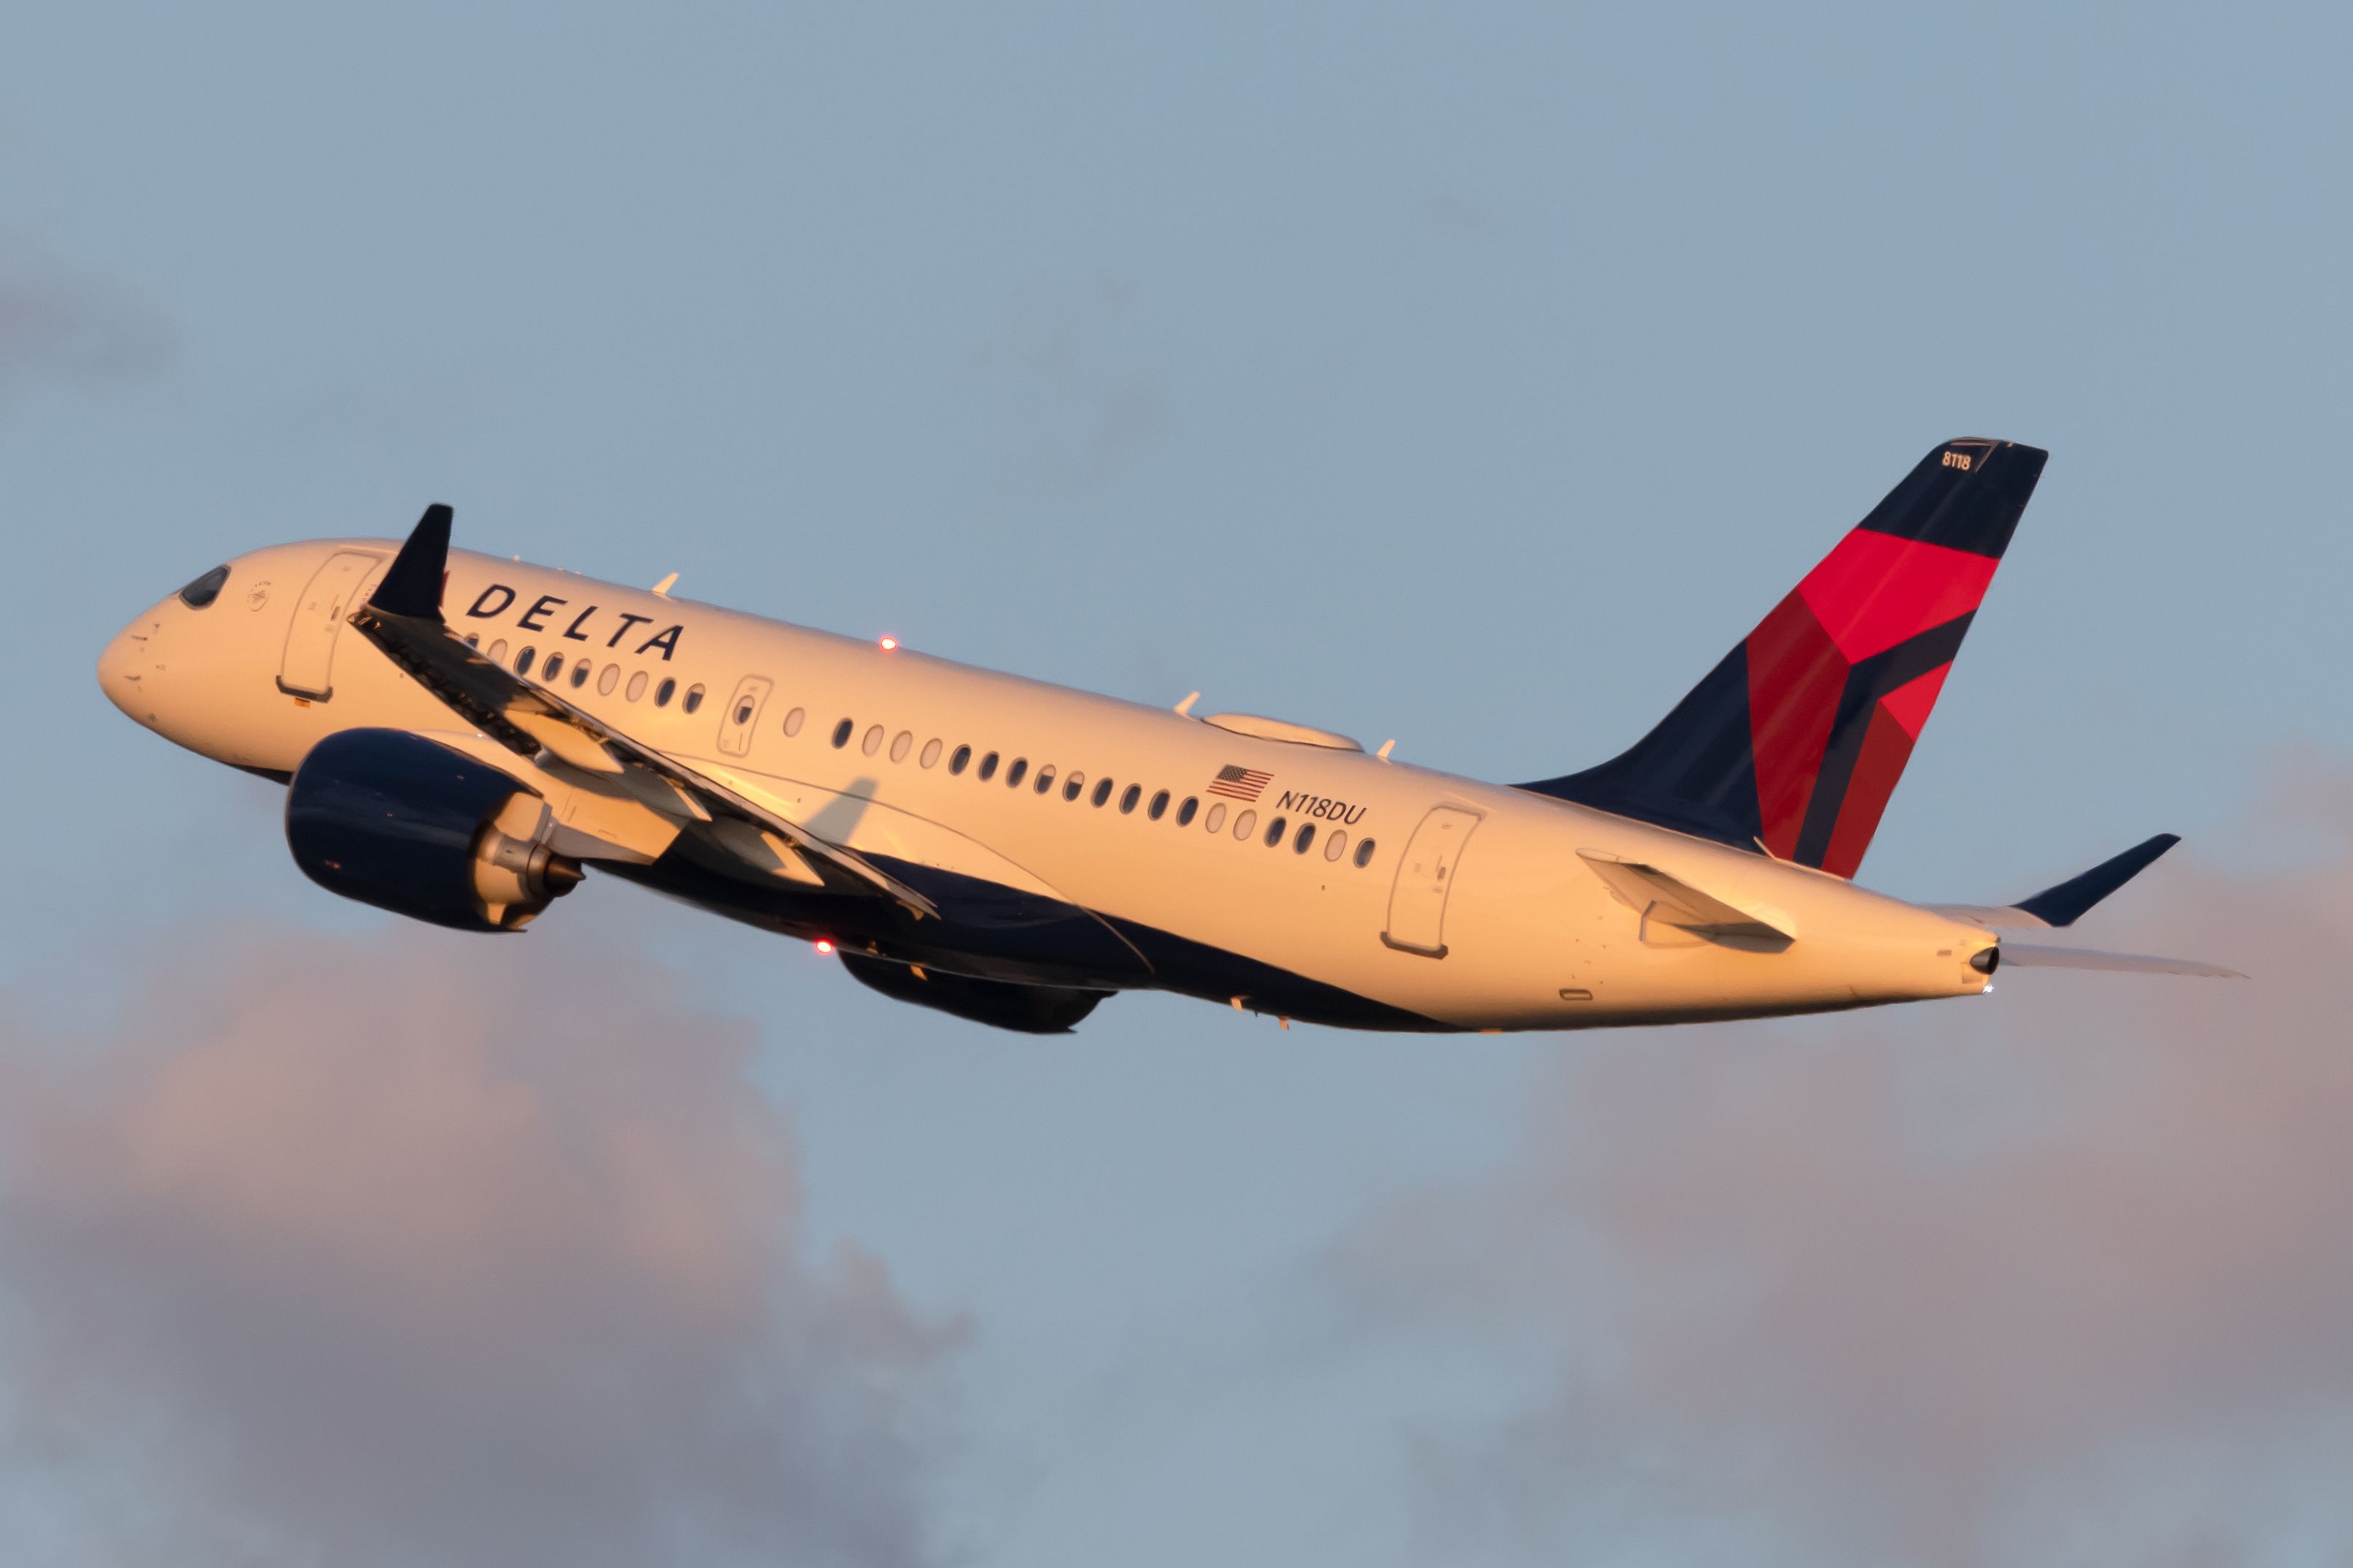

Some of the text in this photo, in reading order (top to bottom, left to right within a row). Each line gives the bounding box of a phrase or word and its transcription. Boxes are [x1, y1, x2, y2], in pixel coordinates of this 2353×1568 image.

[1942, 451, 1971, 471] 8118
[465, 584, 684, 662] DELTA
[1275, 789, 1368, 825] N118DU
